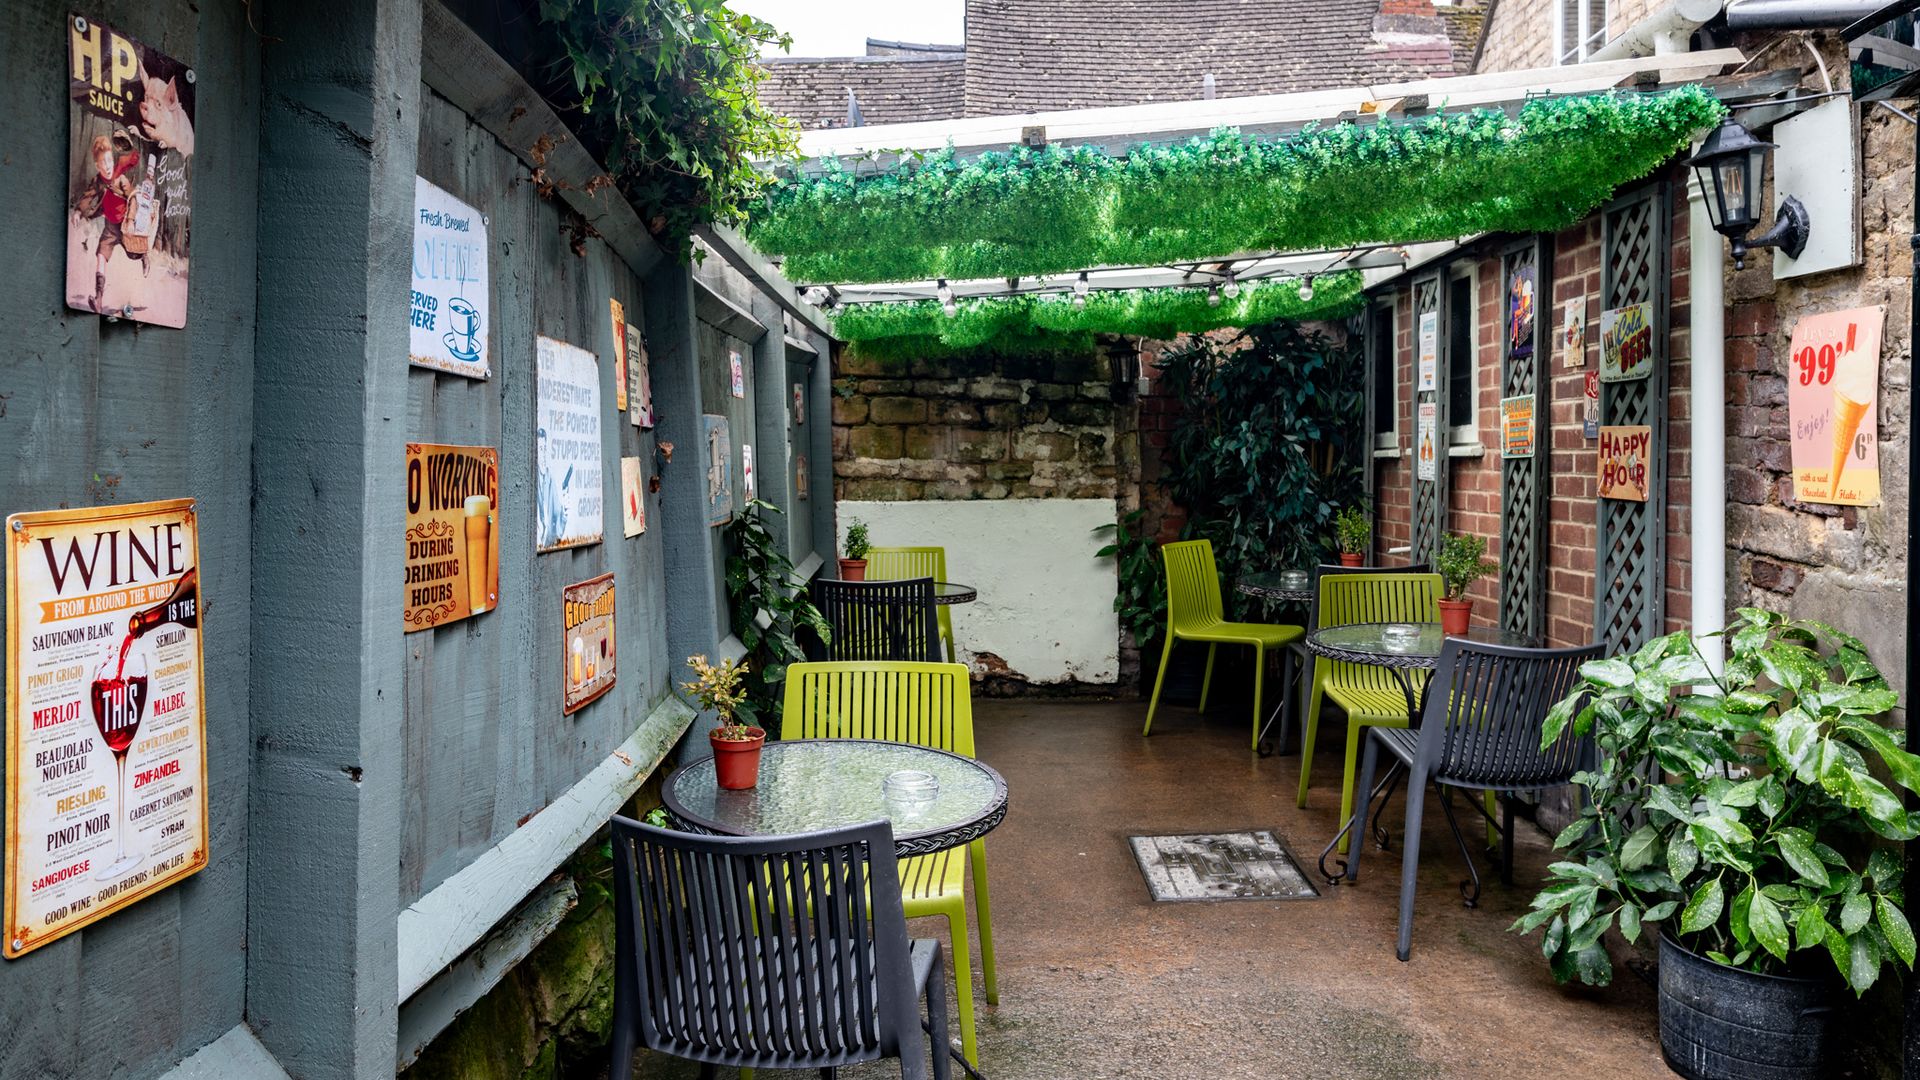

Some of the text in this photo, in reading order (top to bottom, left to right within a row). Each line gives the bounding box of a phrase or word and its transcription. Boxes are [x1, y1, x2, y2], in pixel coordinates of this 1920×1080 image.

[71, 16, 138, 101] H.P.
[89, 90, 124, 117] SAUCE
[156, 154, 185, 184] Good
[164, 180, 189, 200] with
[164, 202, 191, 218] bacon
[420, 208, 470, 233] Fresh Brewed
[412, 236, 480, 282] OFFEE
[410, 290, 438, 312] ERVED
[410, 308, 436, 331] HERE
[1617, 307, 1643, 345] Cold
[1621, 325, 1652, 374] BEER
[538, 377, 592, 408] NDERESTIMATE
[549, 409, 598, 435] THE POWER OF
[1797, 408, 1829, 441] Enjoy!
[551, 439, 600, 461] STUPID PEOPLE
[1599, 431, 1649, 459] HAPPY
[408, 452, 496, 514] O WORKING
[575, 469, 601, 489] IN LARGE
[1603, 463, 1645, 488] HOUR
[1817, 474, 1828, 482] real
[1802, 487, 1827, 498] Chocolate
[578, 497, 601, 517] GROUPS
[37, 522, 185, 595] WINE
[409, 537, 454, 560] DURING
[54, 582, 175, 620] FROM AROUND THE WORLD
[411, 582, 453, 608] HOURS
[168, 599, 196, 622] IS THE
[32, 626, 86, 652] SAUVIGNON
[88, 621, 115, 641] BLANC
[27, 665, 84, 689] PINOT GRIGIO
[154, 659, 192, 679] CHARDONNAY
[33, 700, 81, 730] MERLOT
[102, 684, 138, 732] THIS
[153, 691, 185, 717] MALBEC
[36, 738, 93, 768] BEAUJOLAIS
[42, 755, 87, 783] NOUVEAU
[134, 760, 181, 789] ZINFANDEL
[56, 785, 106, 815] RIESLING
[129, 798, 161, 821] CABERNET
[162, 785, 194, 808] SAUVIGNON
[46, 823, 82, 852] PINOT
[84, 813, 110, 838] NOIR
[161, 819, 185, 838] SYRAH
[32, 859, 90, 892] SANGIOVESE
[45, 905, 68, 925] GOOD
[70, 895, 91, 915] WINE
[98, 885, 118, 903] GOOD
[119, 871, 148, 892] FRIENDS
[153, 860, 170, 877] LONG
[172, 852, 185, 870] LIFE
